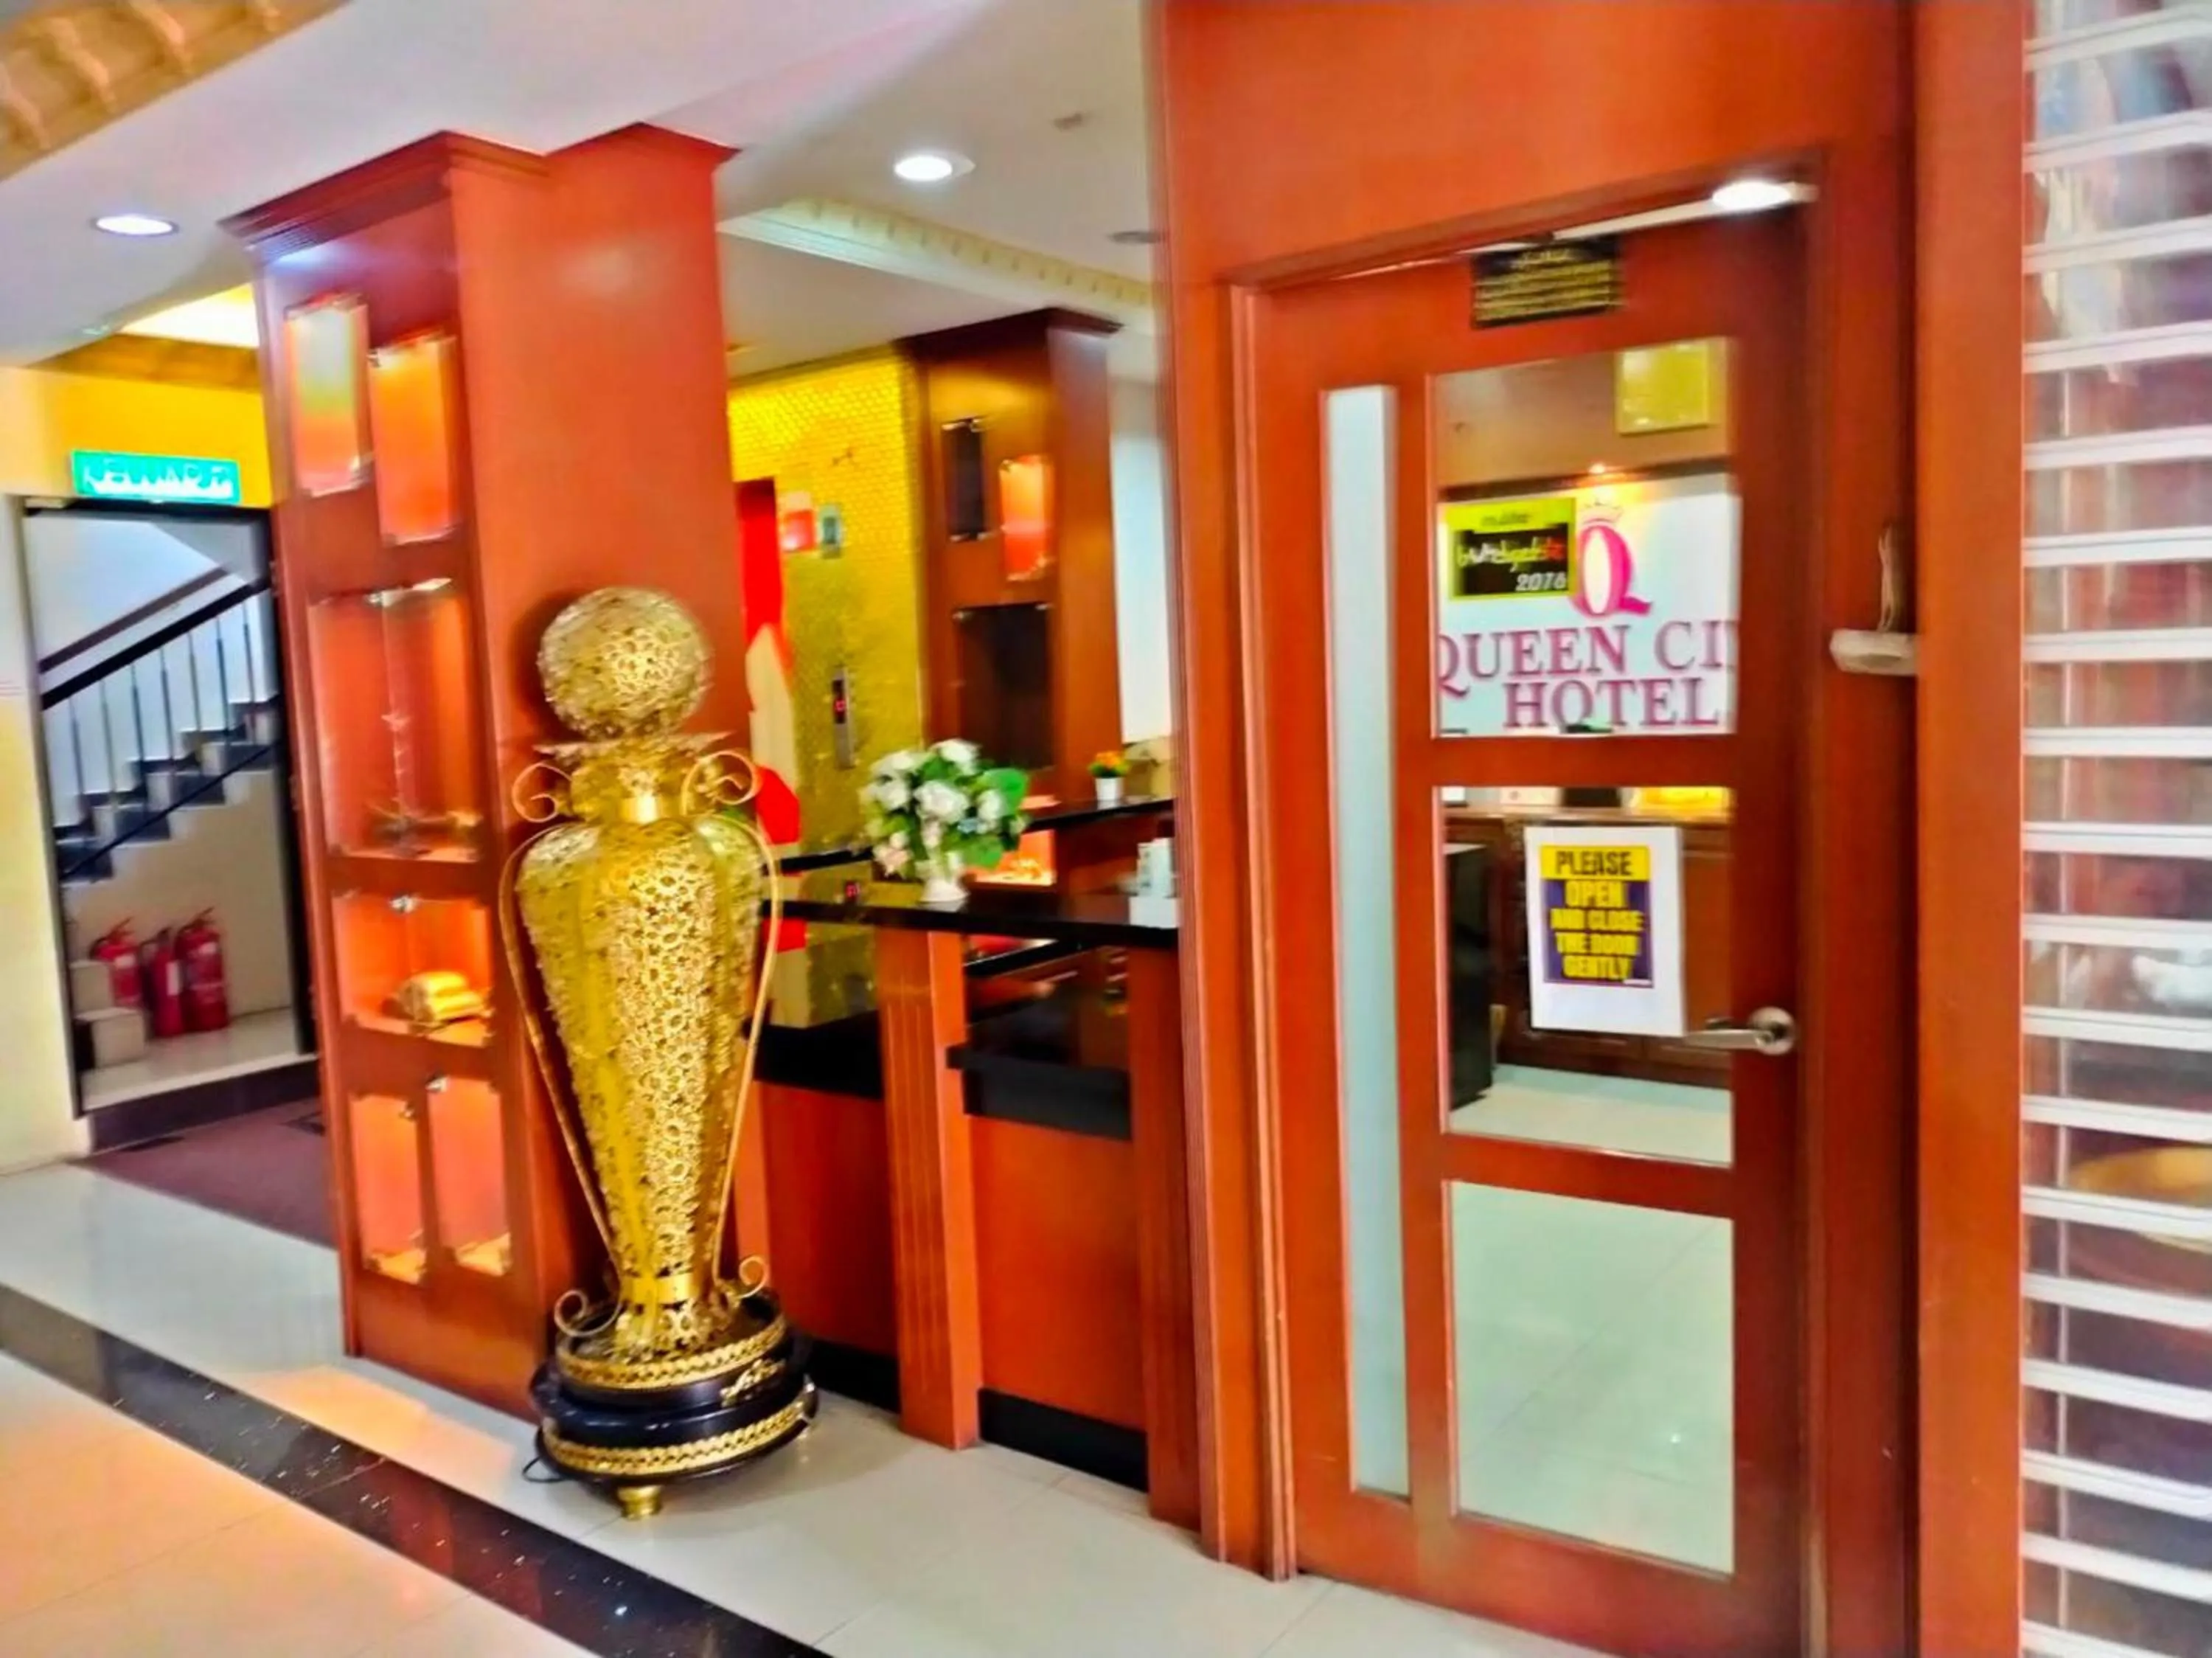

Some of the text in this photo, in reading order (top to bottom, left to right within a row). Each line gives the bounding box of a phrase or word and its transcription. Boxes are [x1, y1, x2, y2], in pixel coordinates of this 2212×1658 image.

[1568, 524, 1652, 618] Q
[1503, 677, 1719, 730] HOTEL
[1555, 850, 1632, 876] PLEASE
